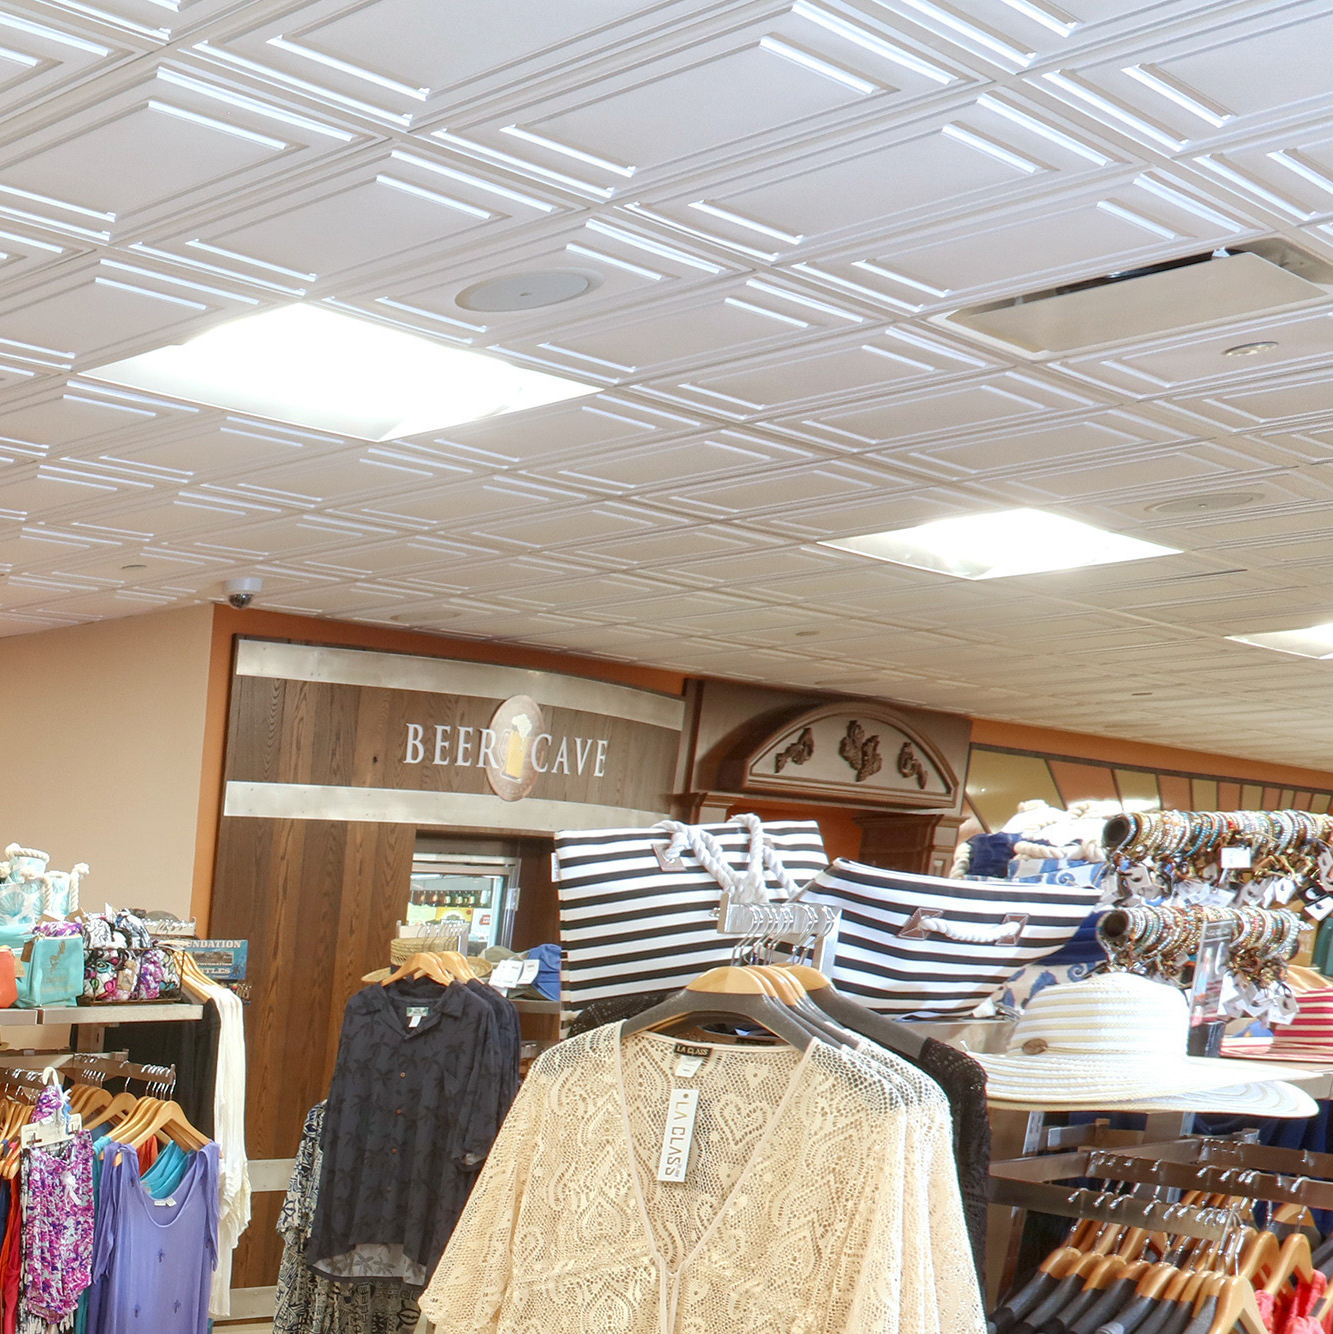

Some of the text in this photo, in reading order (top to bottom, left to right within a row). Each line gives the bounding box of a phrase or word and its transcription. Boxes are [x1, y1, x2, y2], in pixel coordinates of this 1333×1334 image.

[403, 723, 609, 777] BEER CAVE
[187, 940, 242, 948] UNDATION
[676, 1045, 709, 1056] LA CLASS
[665, 1101, 690, 1176] LA CLASS
